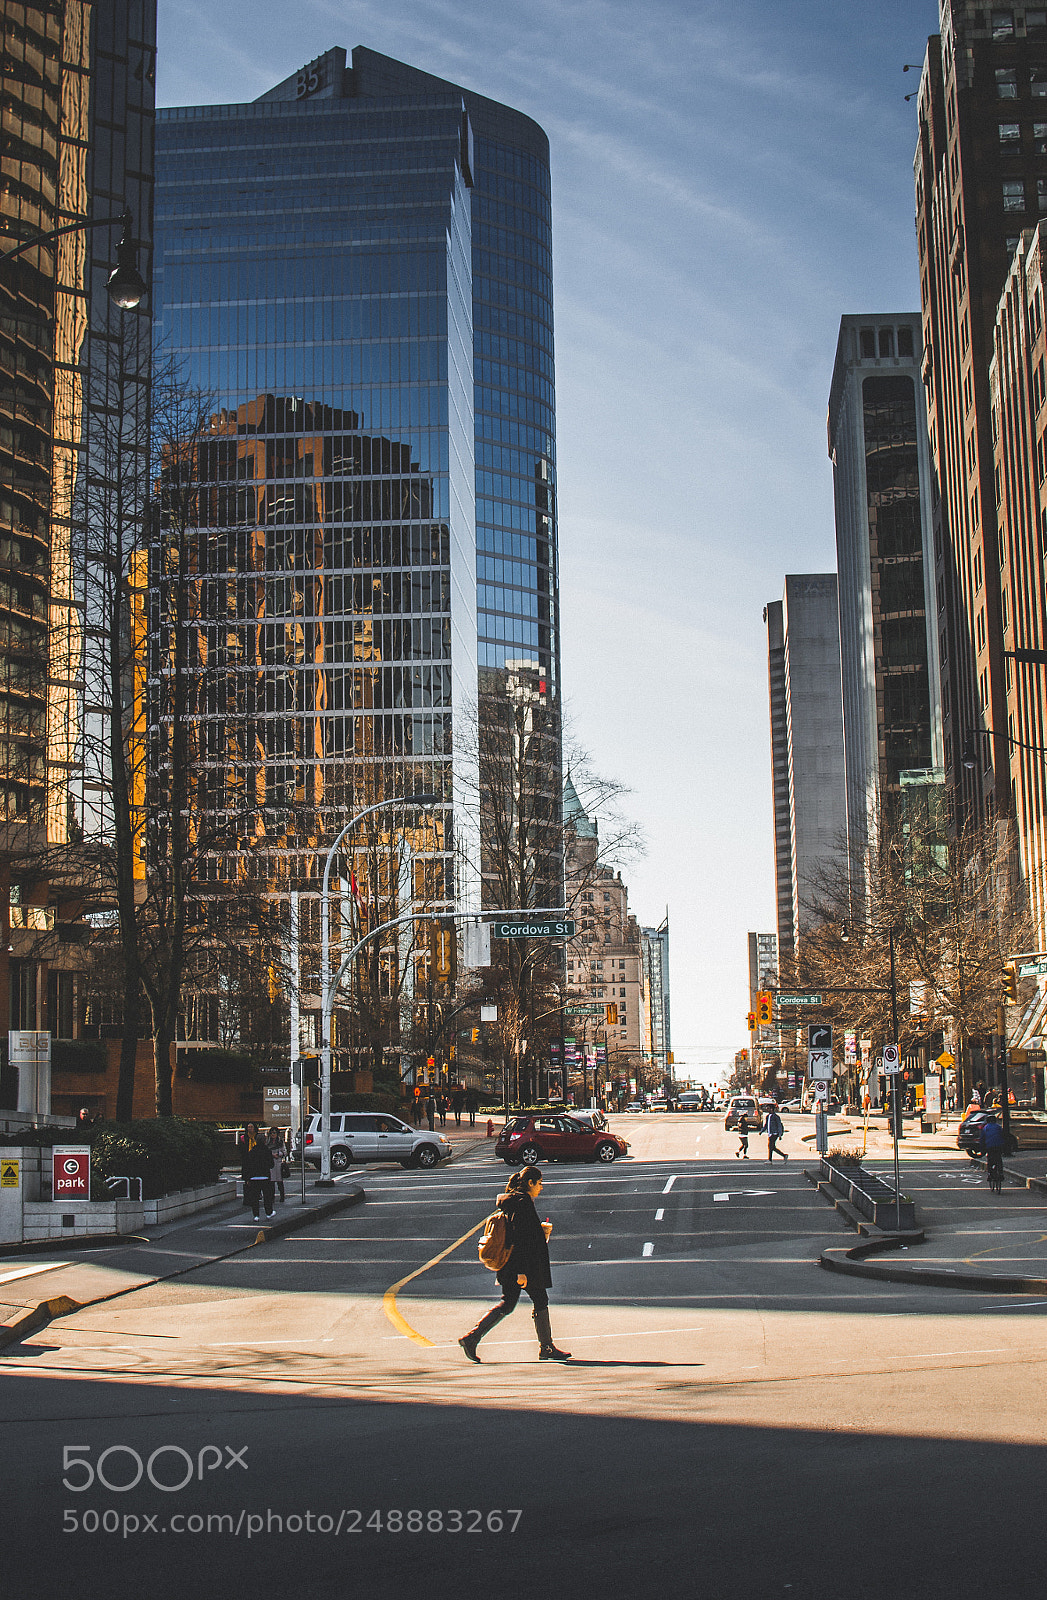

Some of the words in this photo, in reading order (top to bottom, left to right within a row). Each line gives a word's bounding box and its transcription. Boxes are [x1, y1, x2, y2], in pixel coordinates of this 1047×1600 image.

[501, 925, 550, 935] Cordova
[555, 923, 568, 934] St
[57, 1177, 85, 1190] park
